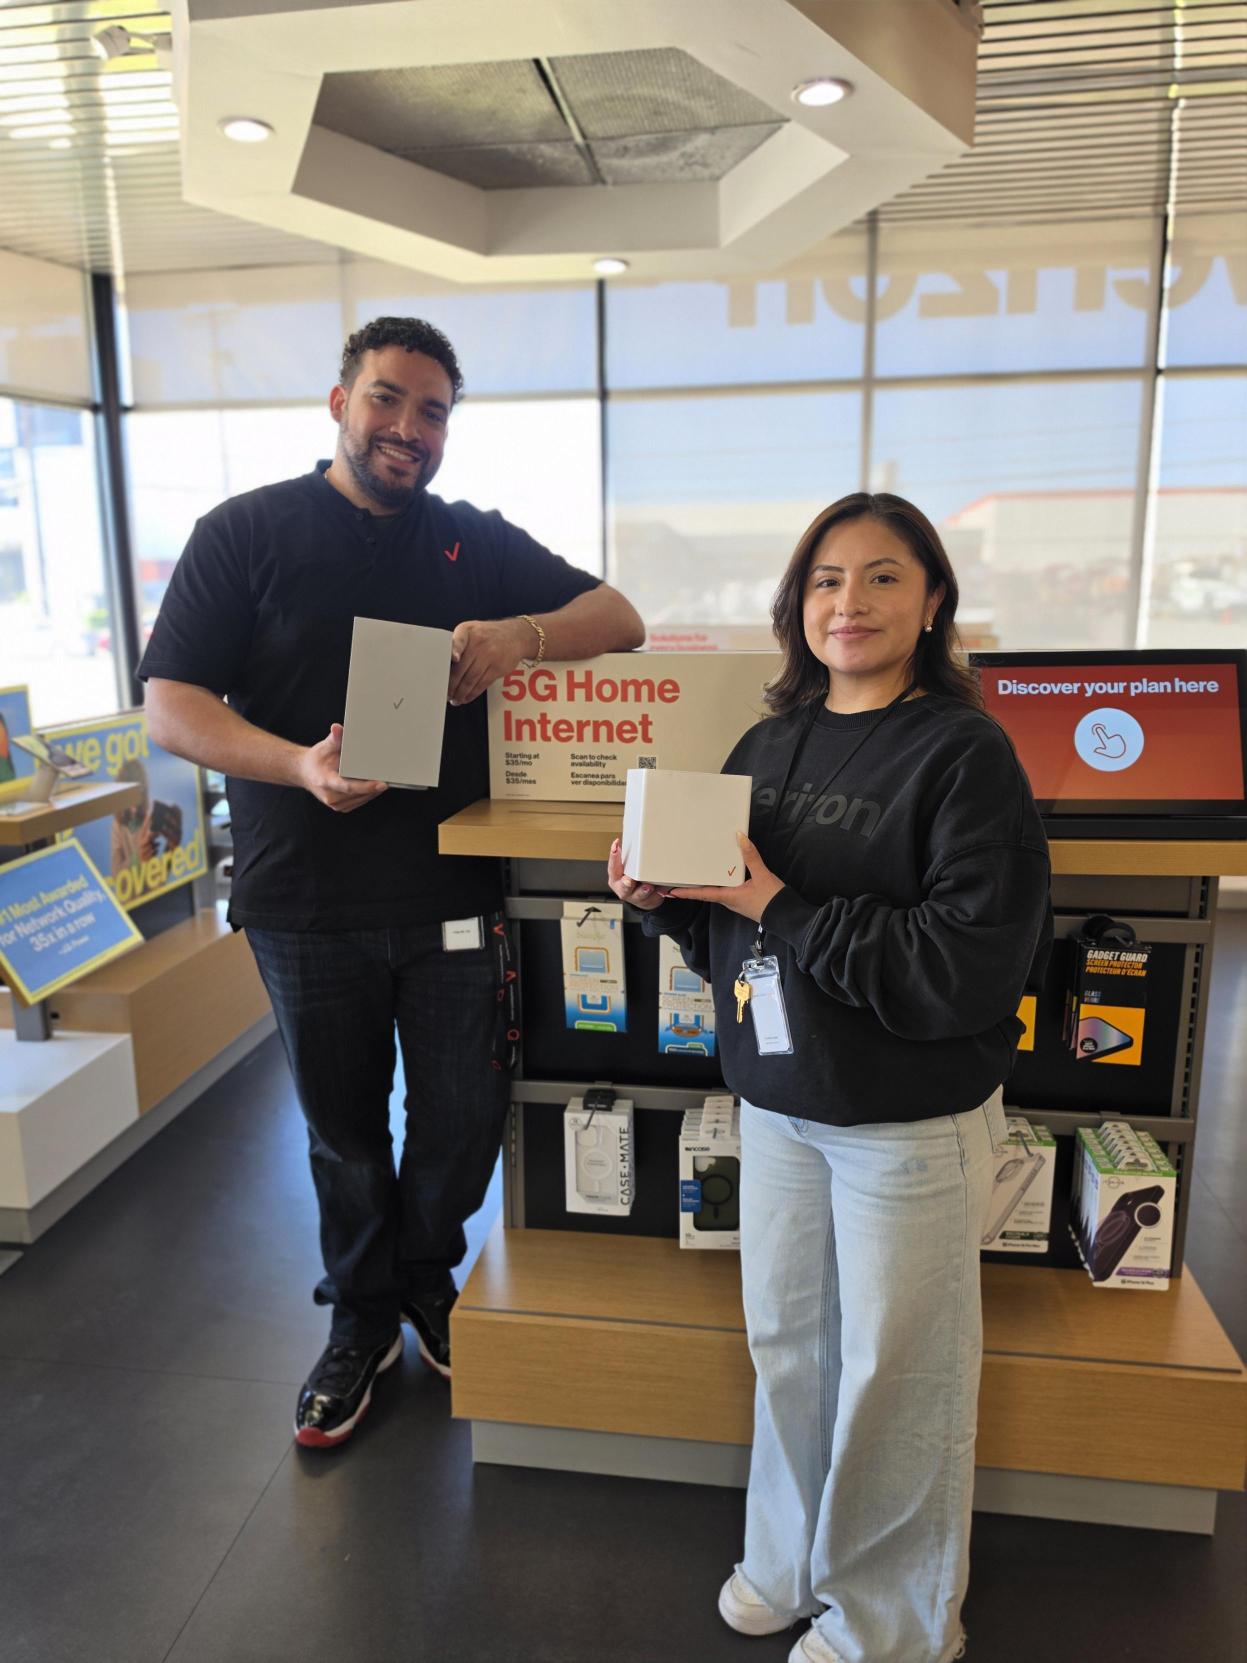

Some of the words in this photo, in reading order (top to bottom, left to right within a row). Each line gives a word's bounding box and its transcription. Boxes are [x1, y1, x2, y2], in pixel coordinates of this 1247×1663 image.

[502, 668, 557, 703] 5G
[565, 669, 681, 704] Home
[997, 679, 1079, 695] Discover
[1084, 681, 1127, 697] your
[1130, 678, 1172, 697] plan
[1174, 677, 1219, 693] here
[503, 710, 653, 744] Internet
[105, 723, 150, 776] got
[505, 752, 532, 761] Starting
[505, 759, 533, 767] $35/mo
[570, 760, 606, 769] availability
[505, 770, 527, 778] Desde
[583, 779, 627, 787] disponibilida
[752, 782, 881, 839] erizon
[102, 830, 200, 899] overed
[14, 904, 68, 938] Network
[1087, 949, 1120, 961] GADGET
[1119, 952, 1148, 963] GUARD
[1085, 966, 1121, 975] PROTECTEUR
[1108, 960, 1143, 968] PROTECTOR
